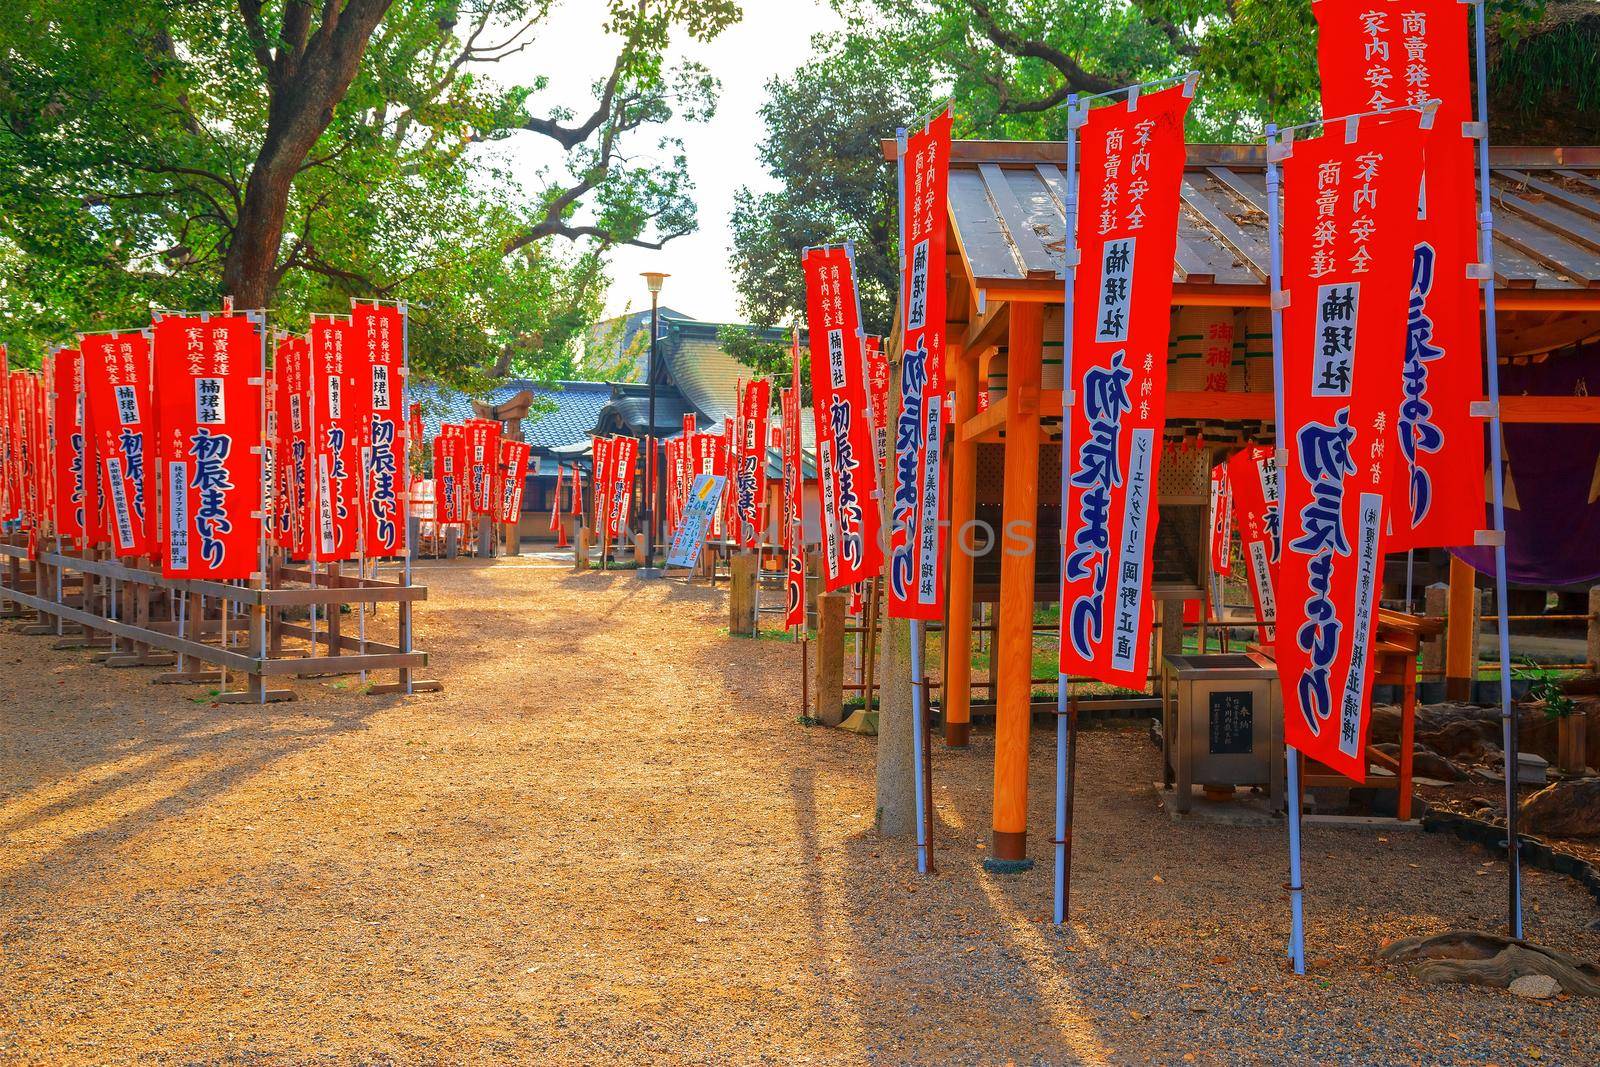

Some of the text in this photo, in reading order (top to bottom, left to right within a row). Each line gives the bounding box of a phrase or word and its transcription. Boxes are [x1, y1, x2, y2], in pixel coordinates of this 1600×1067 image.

[189, 427, 235, 570] 初辰まいり
[370, 413, 397, 549] 初辰まいり
[829, 393, 864, 571] 初辰まいり
